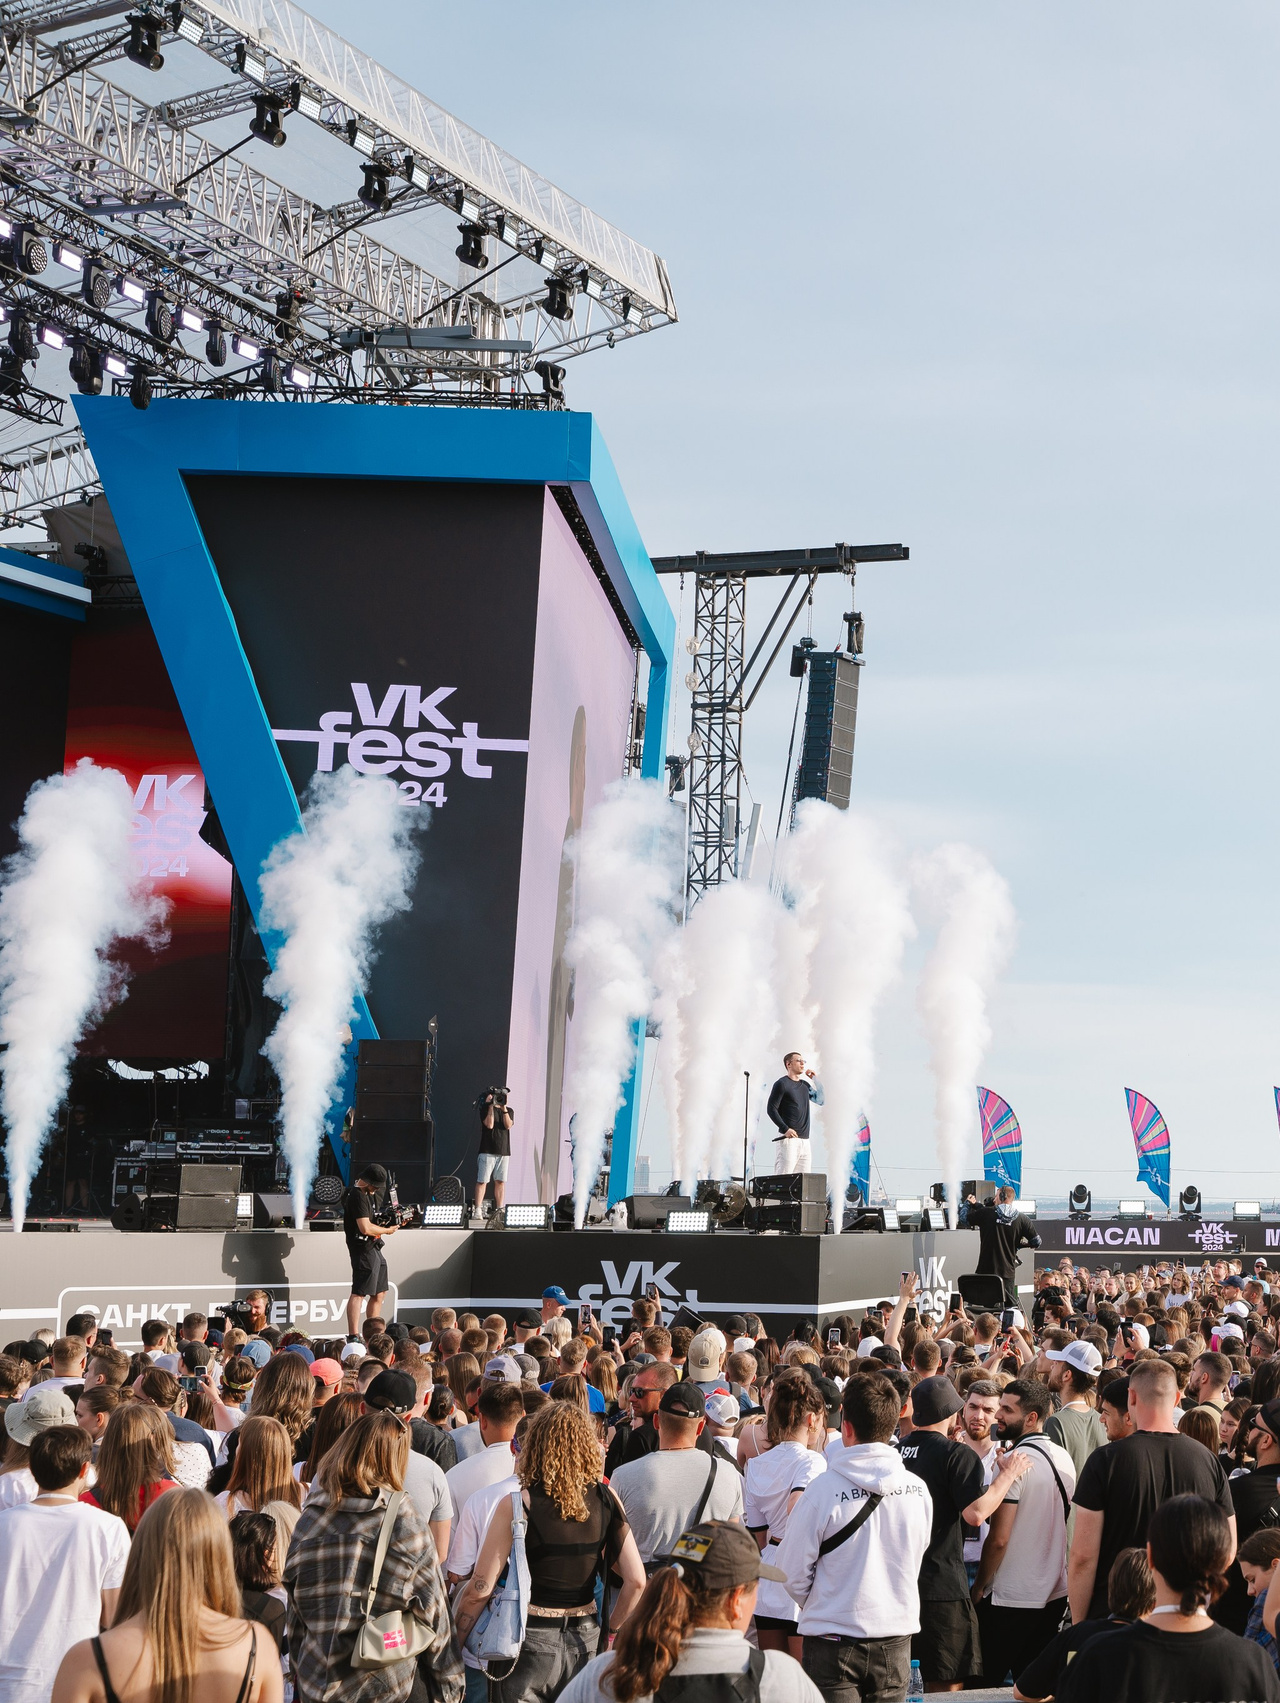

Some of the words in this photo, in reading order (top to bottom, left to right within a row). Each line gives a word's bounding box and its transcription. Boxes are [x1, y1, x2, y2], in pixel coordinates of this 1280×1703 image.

[351, 682, 457, 730] VK
[316, 711, 493, 779] fest
[1065, 1227, 1160, 1246] MACAN
[1188, 1229, 1238, 1244] fest
[1201, 1222, 1225, 1233] VK
[600, 1260, 681, 1296] VK
[919, 1256, 947, 1289] VK
[905, 1485, 924, 1497] APE
